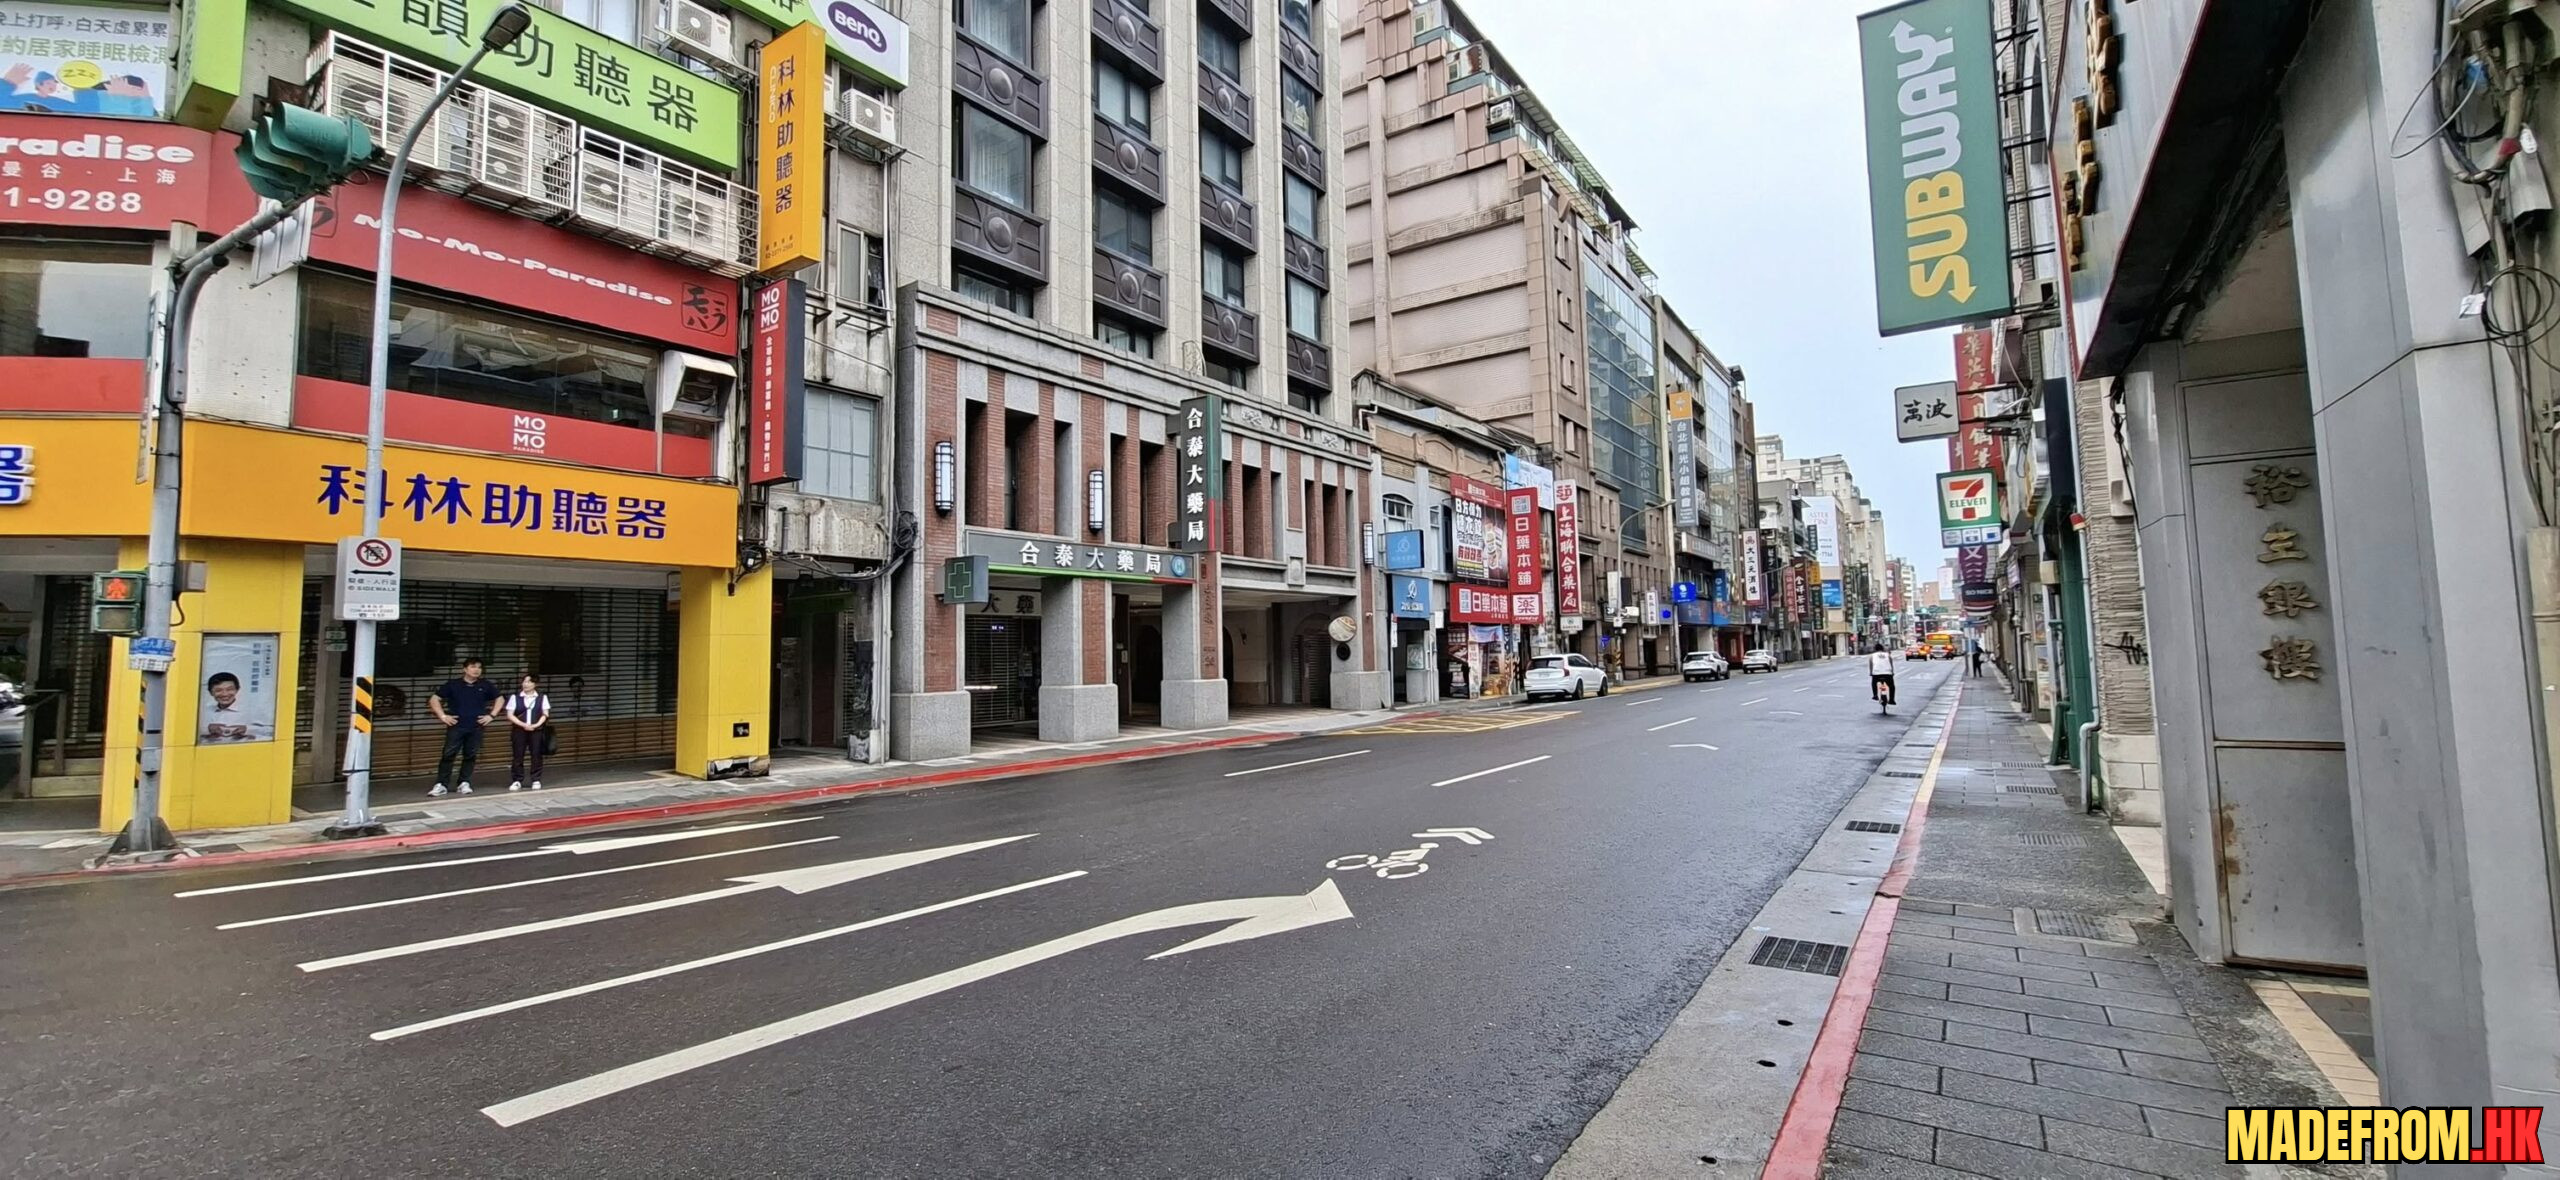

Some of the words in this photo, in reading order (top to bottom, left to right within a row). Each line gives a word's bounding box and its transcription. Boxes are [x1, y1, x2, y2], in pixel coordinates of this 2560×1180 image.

[834, 9, 882, 48] BenQ
[775, 54, 796, 214] 科林助聽器
[1889, 18, 1978, 304] SUBWAY
[353, 212, 673, 307] Mo-Mo-Paradise
[761, 287, 780, 307] MO
[760, 308, 780, 328] MO
[513, 414, 546, 431] MO
[1903, 397, 1953, 424] 萬波
[512, 432, 545, 449] MO
[1187, 406, 1204, 543] 合泰大藥局
[317, 464, 668, 540] 科林助聽器
[1948, 478, 1985, 520] 7
[1018, 540, 1161, 575] 合泰大藥局
